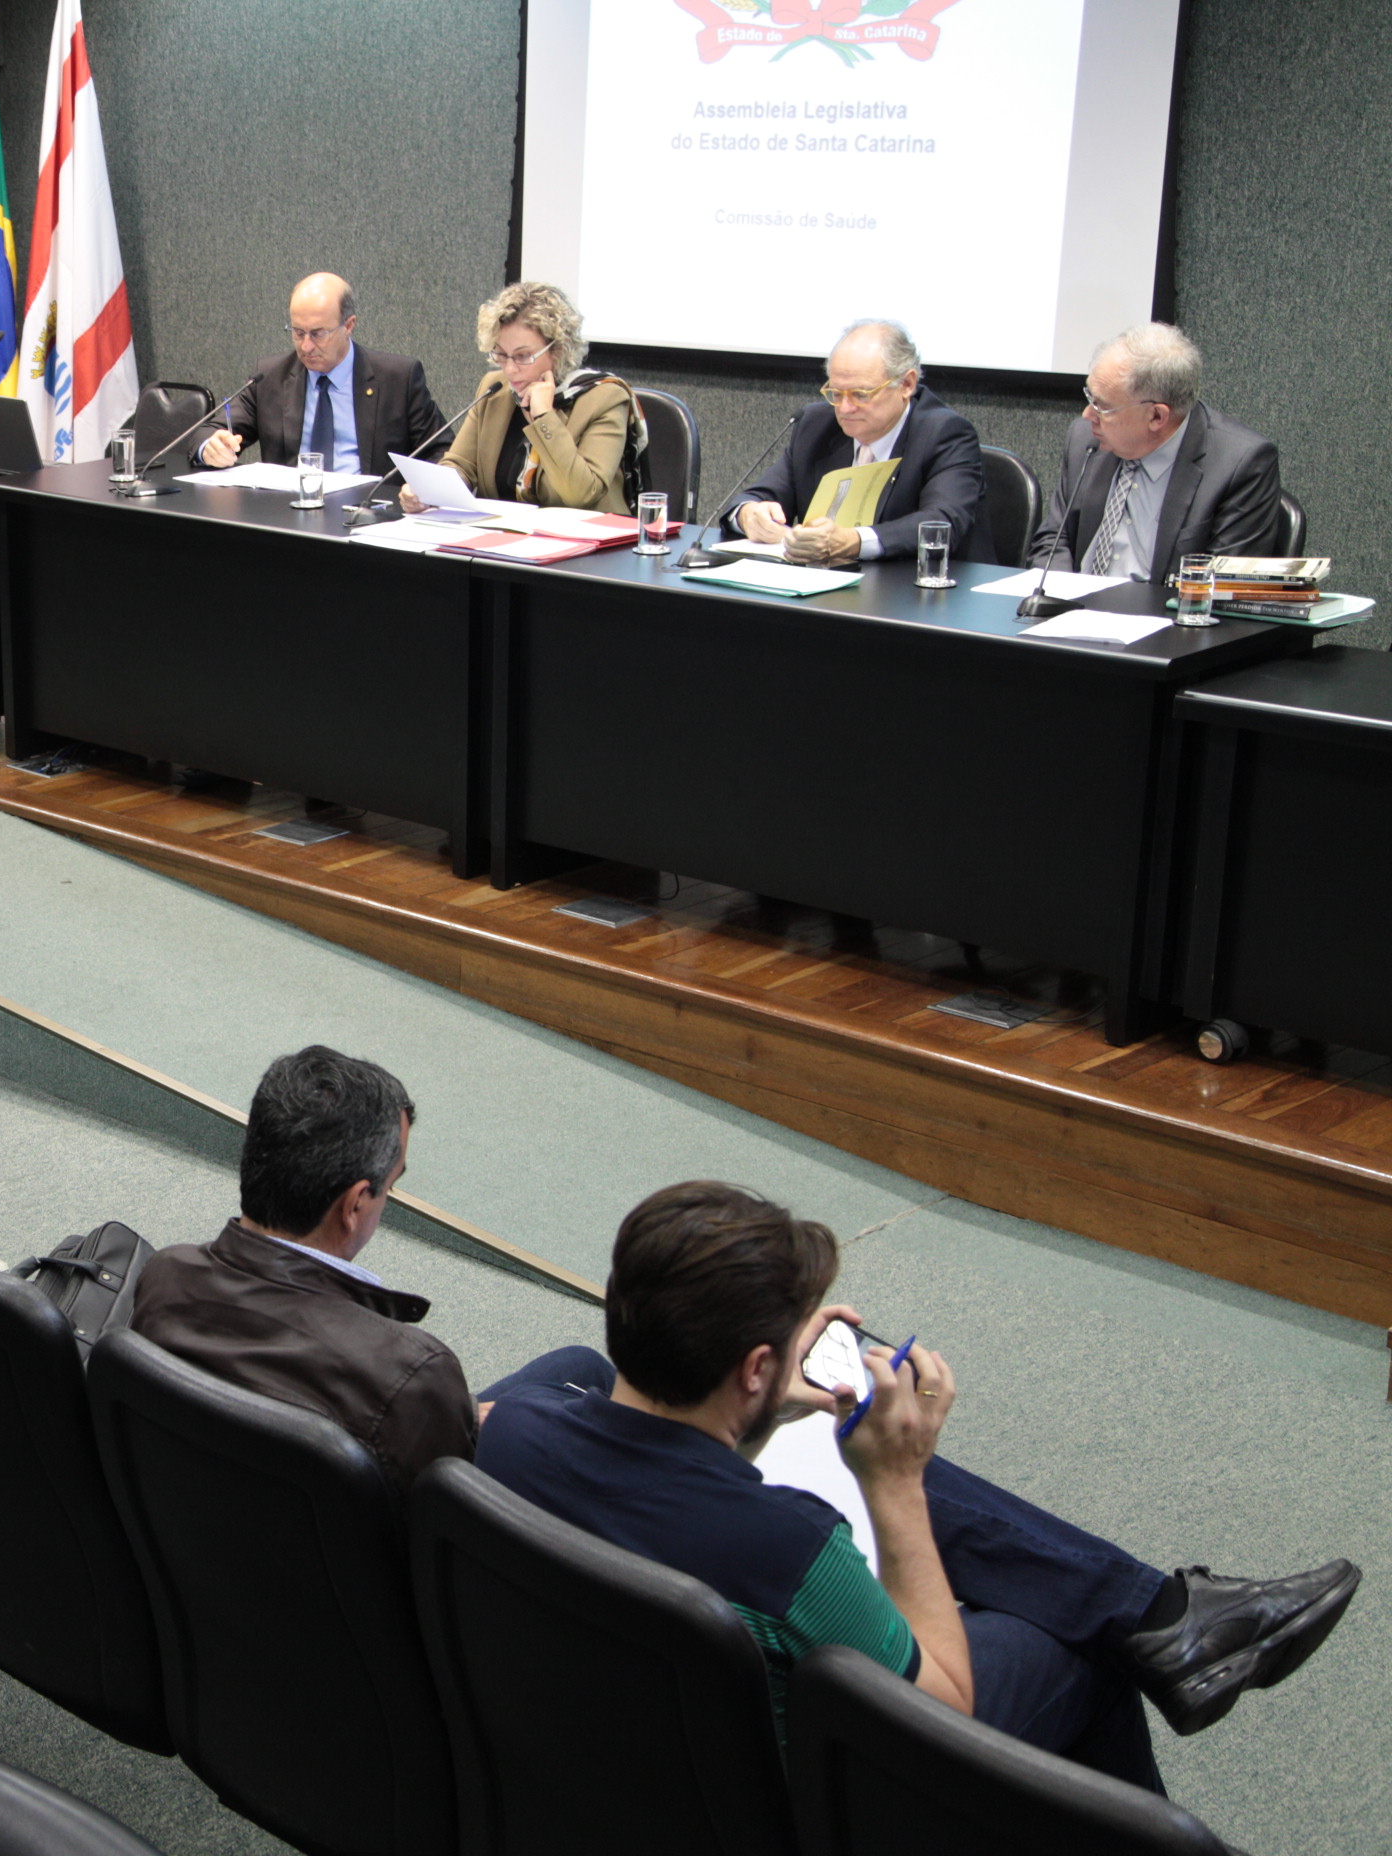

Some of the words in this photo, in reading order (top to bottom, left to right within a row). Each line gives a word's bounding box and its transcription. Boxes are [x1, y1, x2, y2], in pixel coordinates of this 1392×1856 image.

[717, 27, 763, 43] Estado
[766, 31, 783, 42] de
[834, 29, 860, 41] Sta.
[864, 24, 928, 42] Catarina
[693, 100, 797, 119] Assembleia
[804, 100, 908, 124] Legislativa
[671, 133, 693, 150] do
[699, 132, 760, 151] Estado
[767, 133, 789, 151] de
[795, 133, 848, 152] Santa
[854, 133, 937, 154] Catarina
[714, 208, 794, 227] Comissão
[799, 212, 819, 228] de
[824, 212, 878, 231] Saúde
